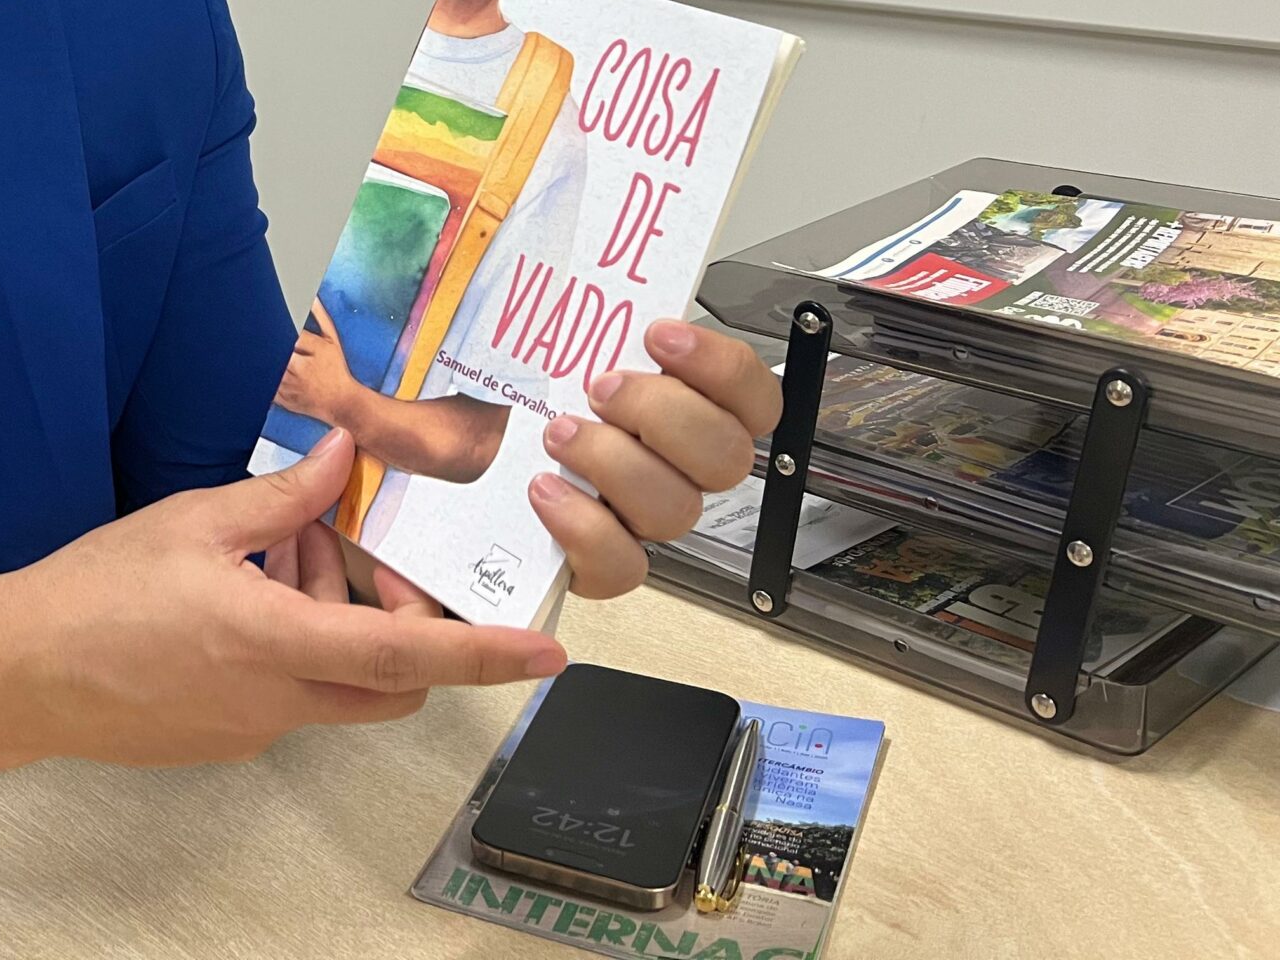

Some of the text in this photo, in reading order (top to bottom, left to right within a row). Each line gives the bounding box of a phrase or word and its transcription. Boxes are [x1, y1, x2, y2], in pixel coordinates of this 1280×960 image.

[578, 39, 720, 168] COISA
[598, 172, 681, 284] DE
[491, 254, 633, 395] VIADO
[436, 350, 558, 421] Samuel de Carvalho
[532, 806, 635, 848] 12:42
